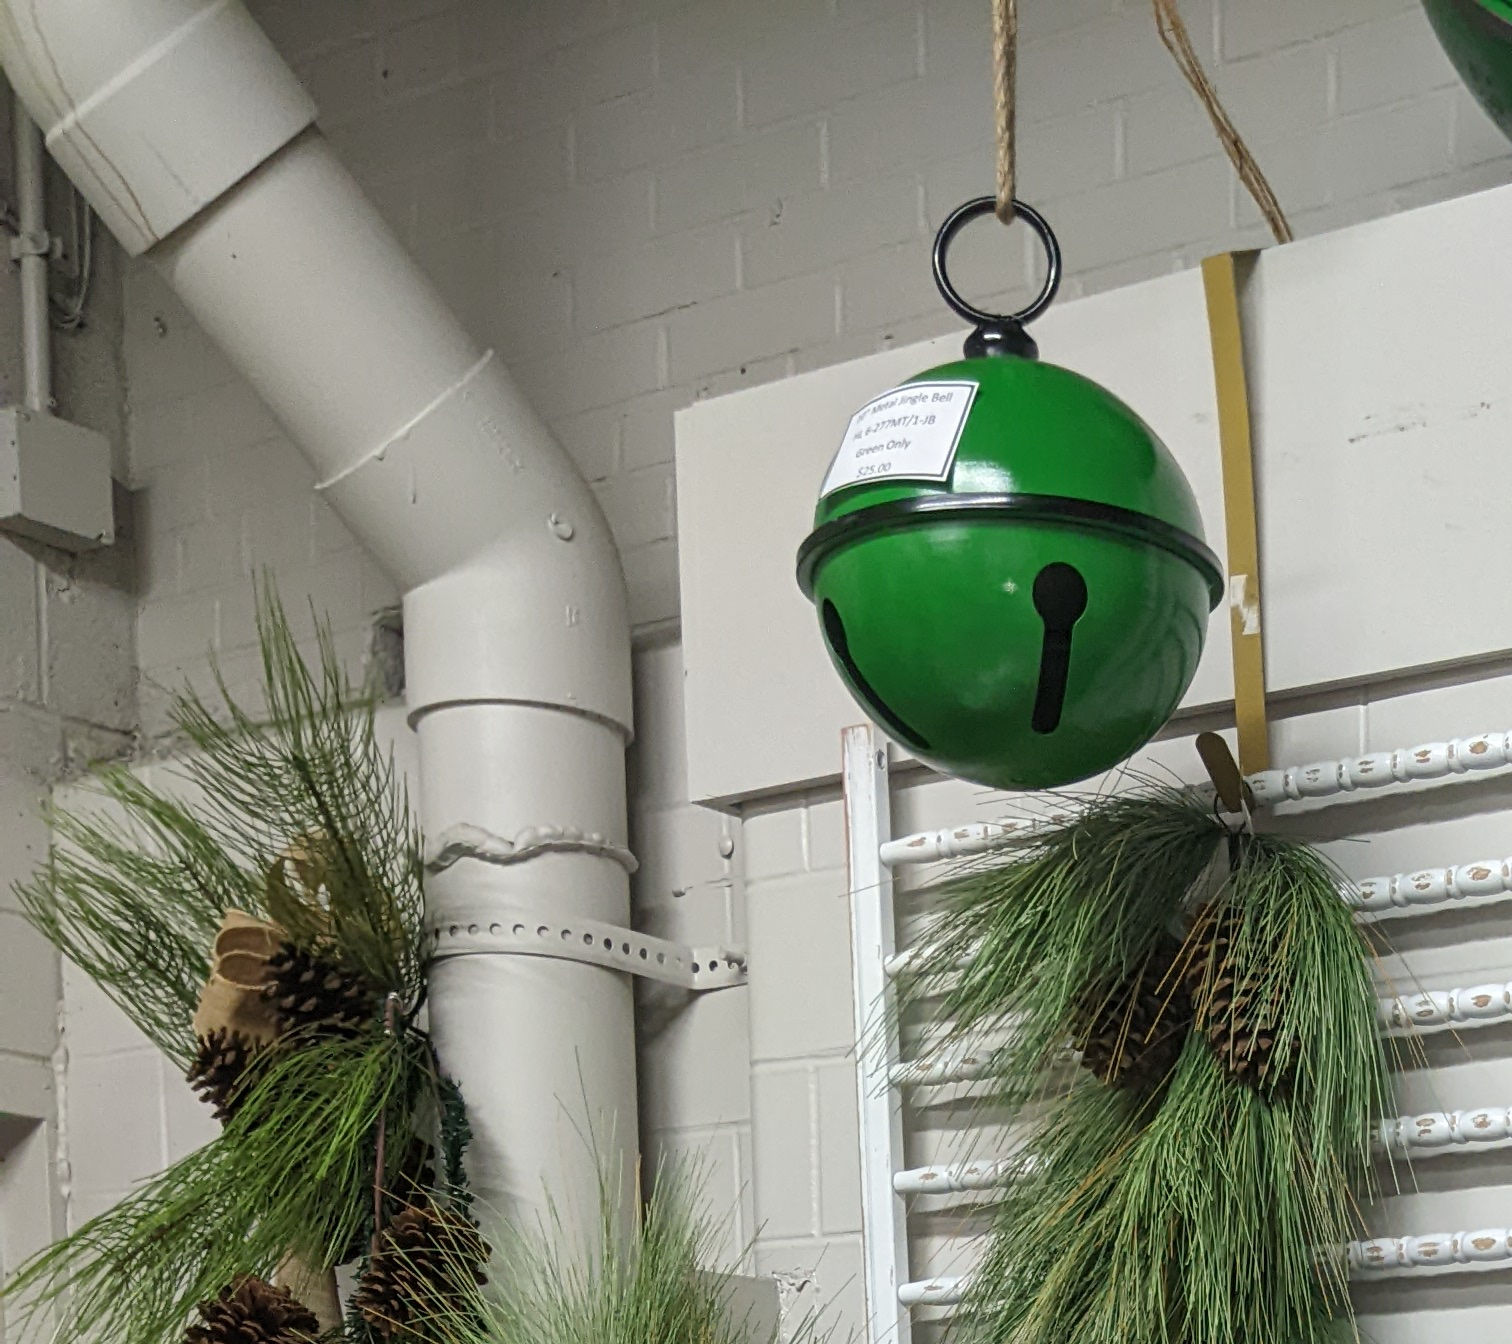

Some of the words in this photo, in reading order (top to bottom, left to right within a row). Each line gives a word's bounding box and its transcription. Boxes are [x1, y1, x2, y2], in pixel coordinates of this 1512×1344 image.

[897, 392, 929, 407] Jingle
[931, 392, 954, 403] Bell
[886, 438, 911, 451] Only
